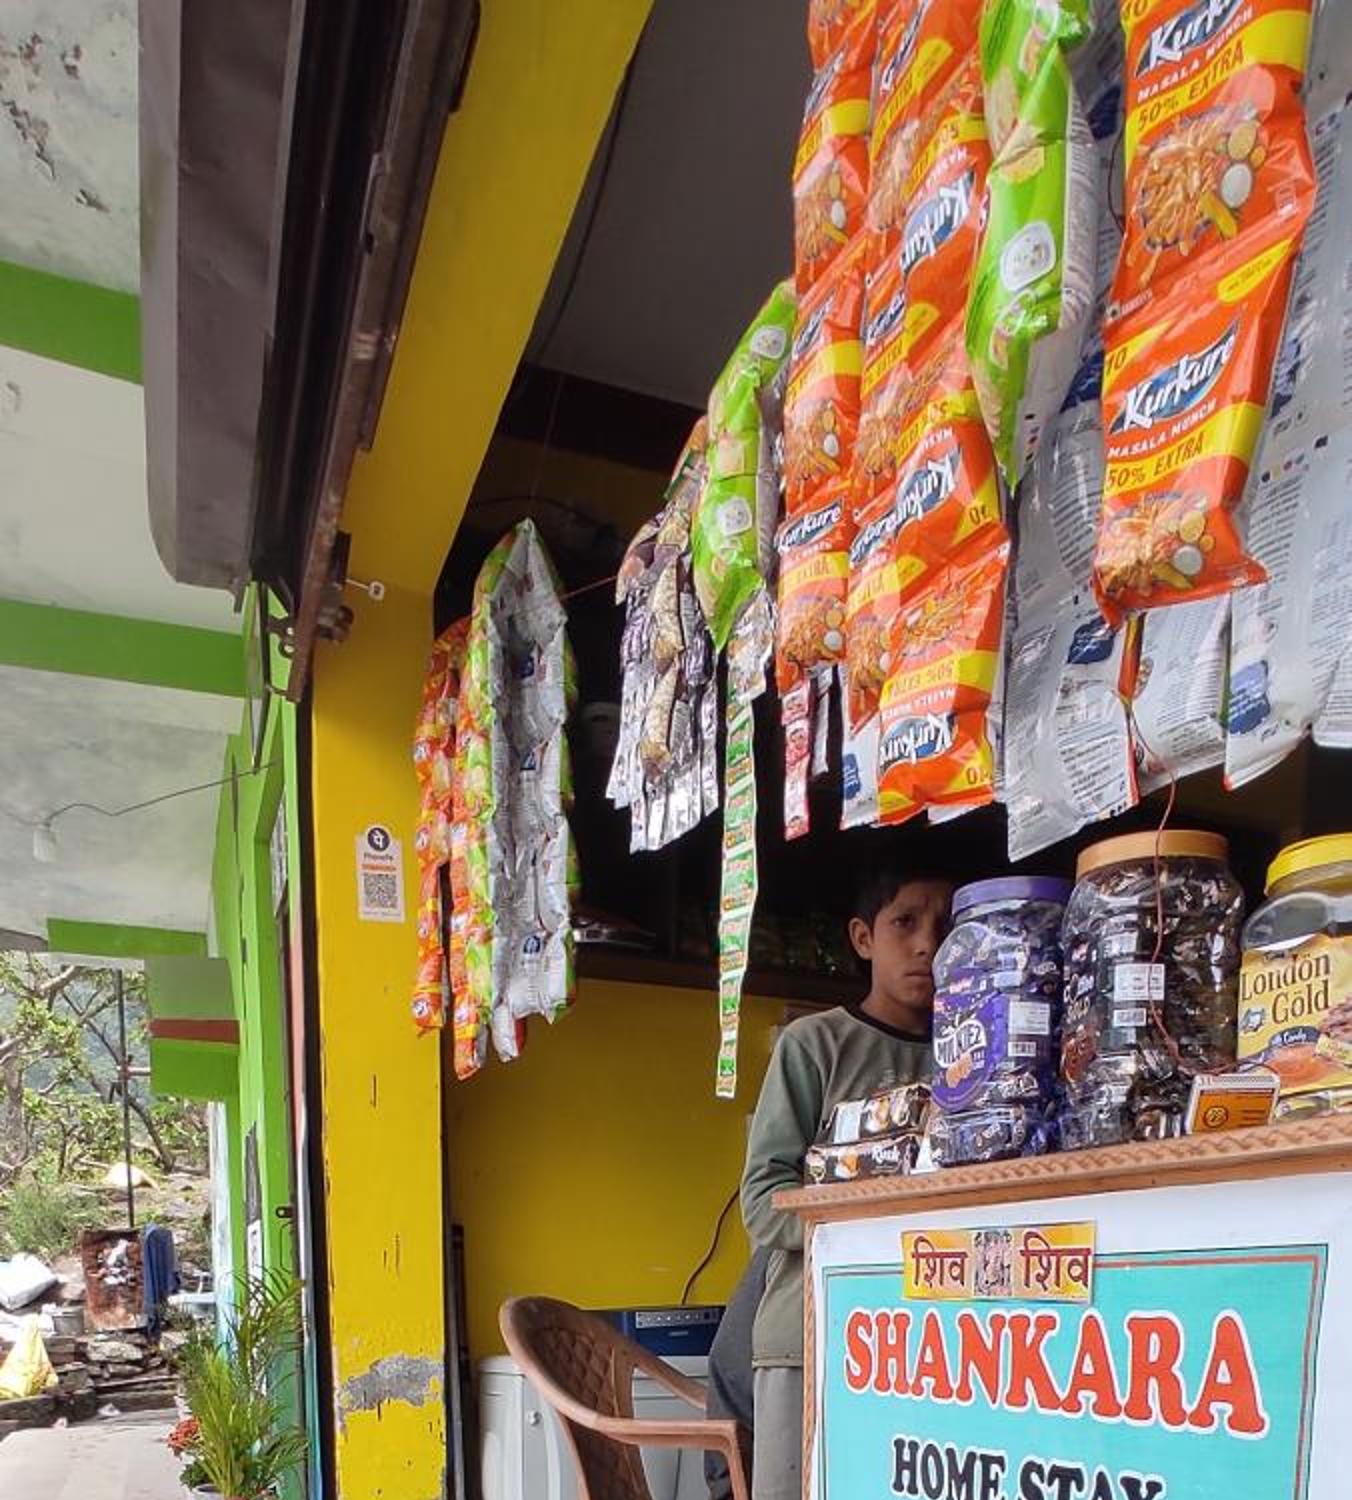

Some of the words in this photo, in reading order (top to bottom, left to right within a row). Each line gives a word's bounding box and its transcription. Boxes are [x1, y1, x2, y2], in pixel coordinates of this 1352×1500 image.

[1188, 39, 1245, 100] EXTRA
[1106, 433, 1167, 459] MASALA
[1171, 397, 1218, 436] MUNCH
[1105, 466, 1147, 491] 50%
[1154, 431, 1205, 473] EXTRA
[911, 1236, 968, 1290] शिव
[1020, 1233, 1092, 1291] शिव
[844, 1309, 1267, 1436] SHANKARA
